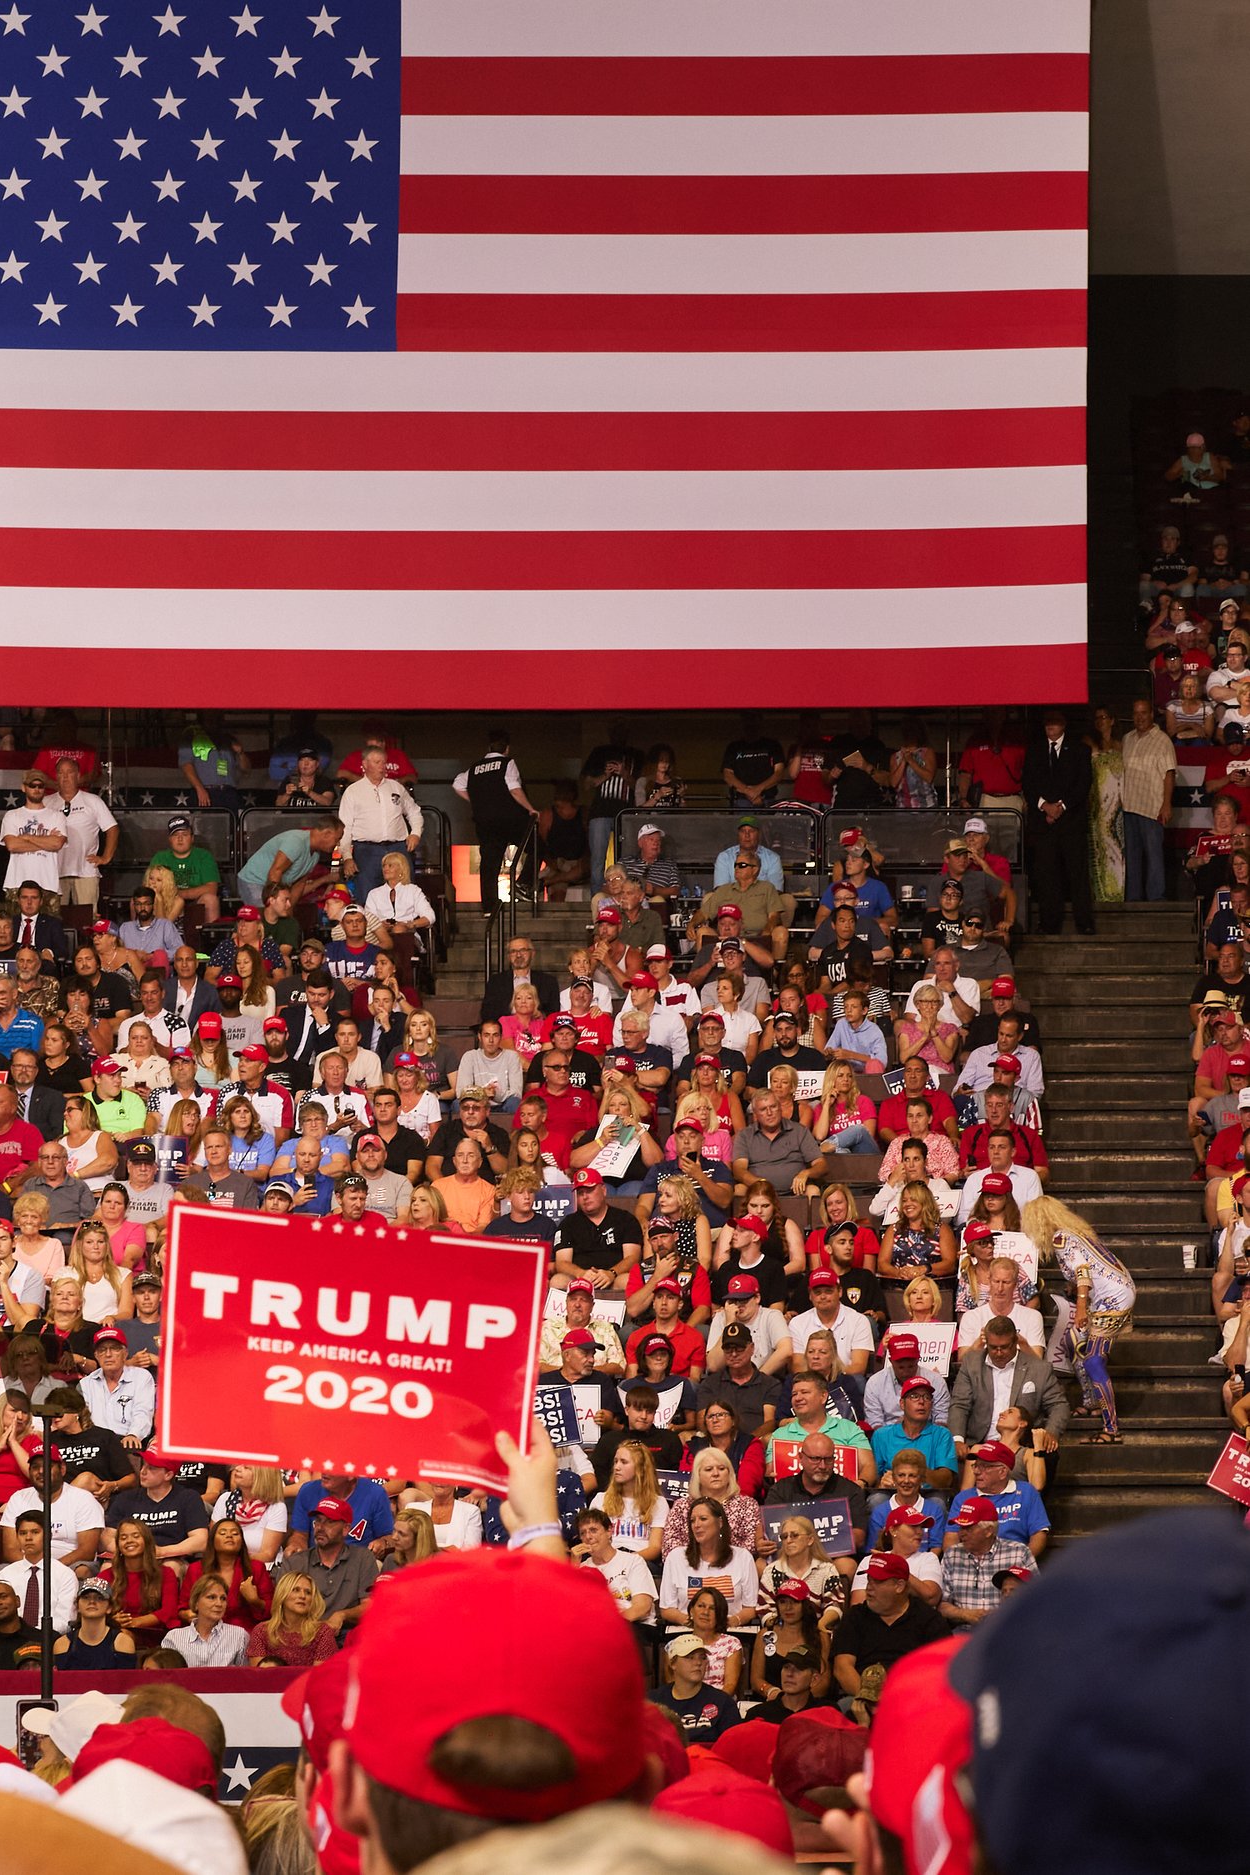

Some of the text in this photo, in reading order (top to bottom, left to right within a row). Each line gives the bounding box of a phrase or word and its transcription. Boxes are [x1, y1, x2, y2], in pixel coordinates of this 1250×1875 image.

[474, 761, 502, 775] USHER
[828, 962, 847, 982] USA
[190, 1271, 518, 1351] TRUMP
[247, 1336, 453, 1374] KEEP AMERICA GREAT!
[263, 1365, 434, 1419] 2020
[132, 1510, 178, 1521] TRUMP
[769, 1515, 845, 1534] TMP
